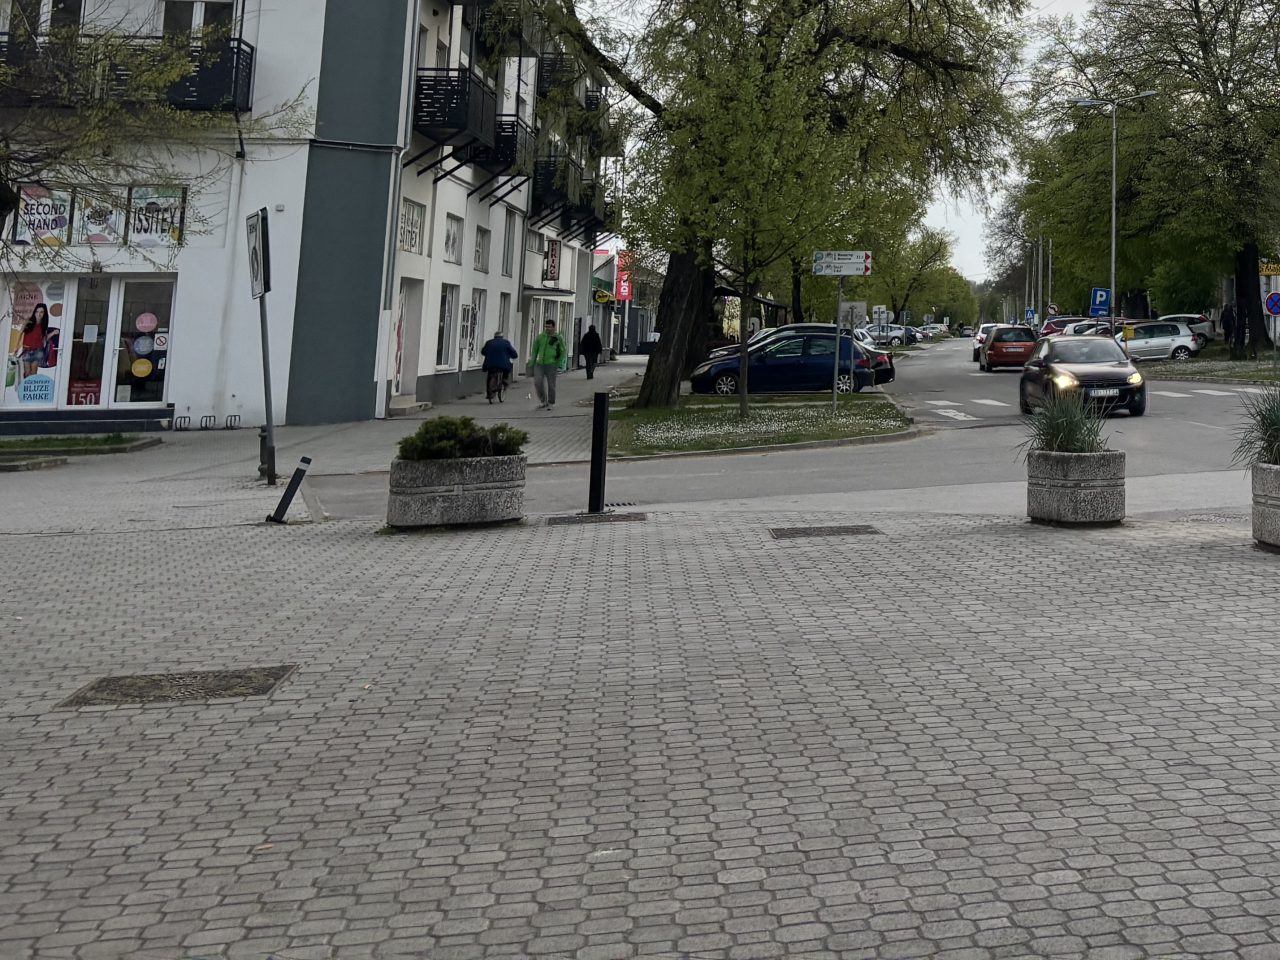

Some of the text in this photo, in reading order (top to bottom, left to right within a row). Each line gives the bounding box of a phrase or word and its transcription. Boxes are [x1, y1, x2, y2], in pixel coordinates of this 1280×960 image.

[24, 202, 66, 216] SECOND
[28, 218, 59, 231] HAND
[132, 206, 177, 235] ISSITEX
[1096, 291, 1106, 304] P
[71, 392, 96, 405] 150
